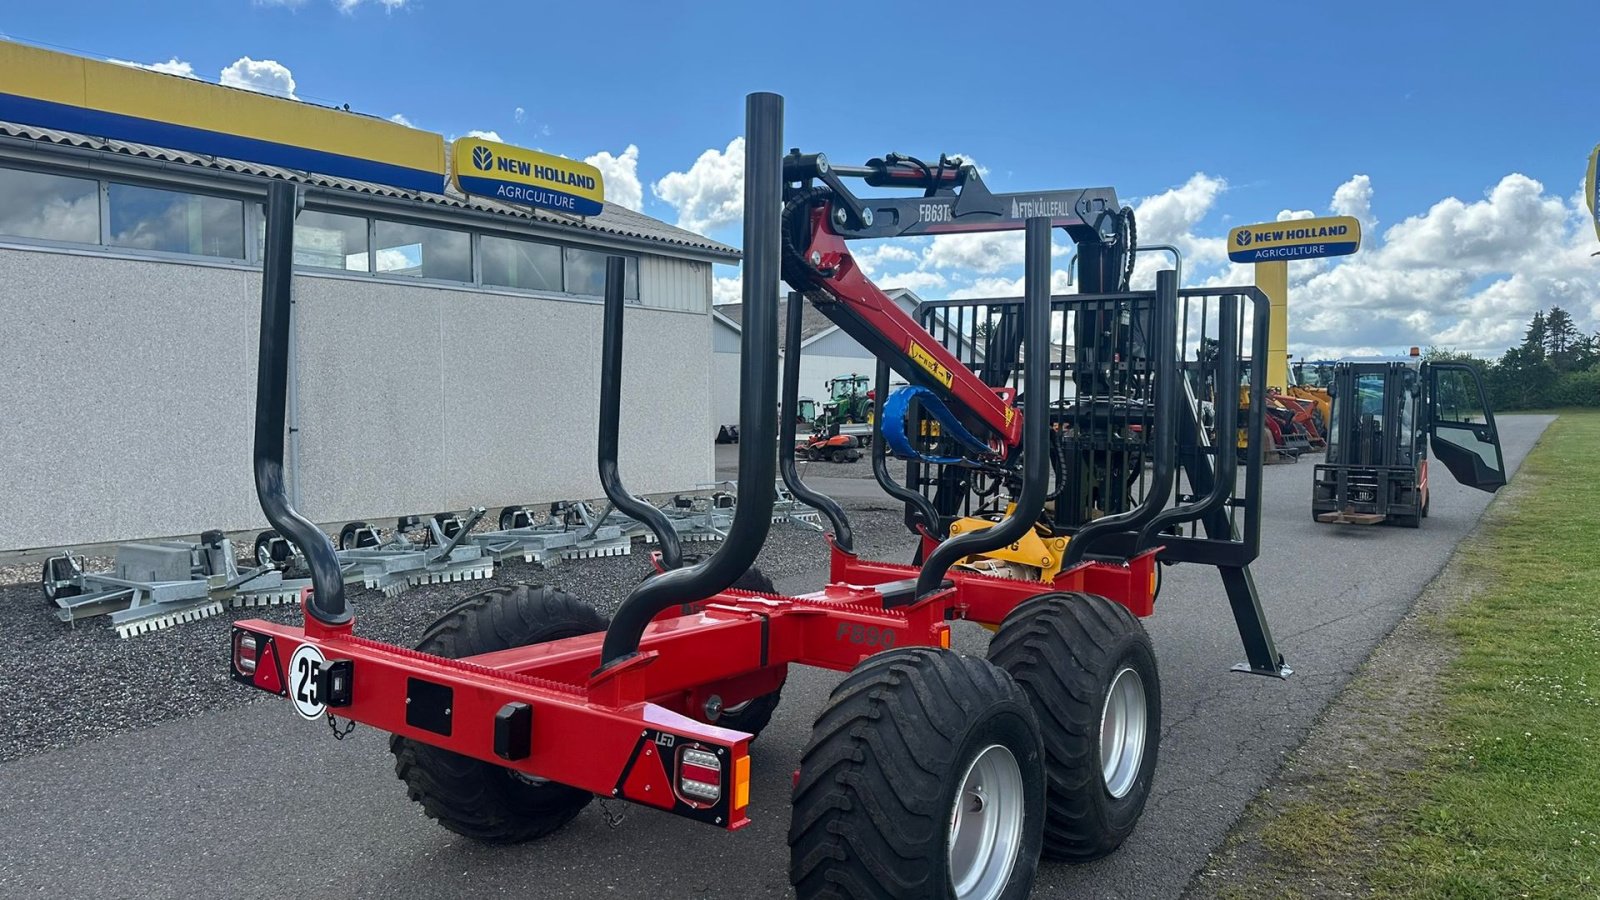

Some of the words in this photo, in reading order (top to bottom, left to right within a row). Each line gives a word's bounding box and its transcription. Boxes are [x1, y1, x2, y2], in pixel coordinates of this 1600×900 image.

[497, 156, 531, 177] NEW
[534, 164, 595, 190] HOLLAND
[497, 184, 575, 209] AGRICULTURE
[1255, 230, 1284, 242] NEW
[1286, 225, 1347, 239] HOLLAND
[1255, 245, 1325, 258] AGRICULTURE
[297, 656, 320, 706] 25
[655, 731, 675, 747] LED
